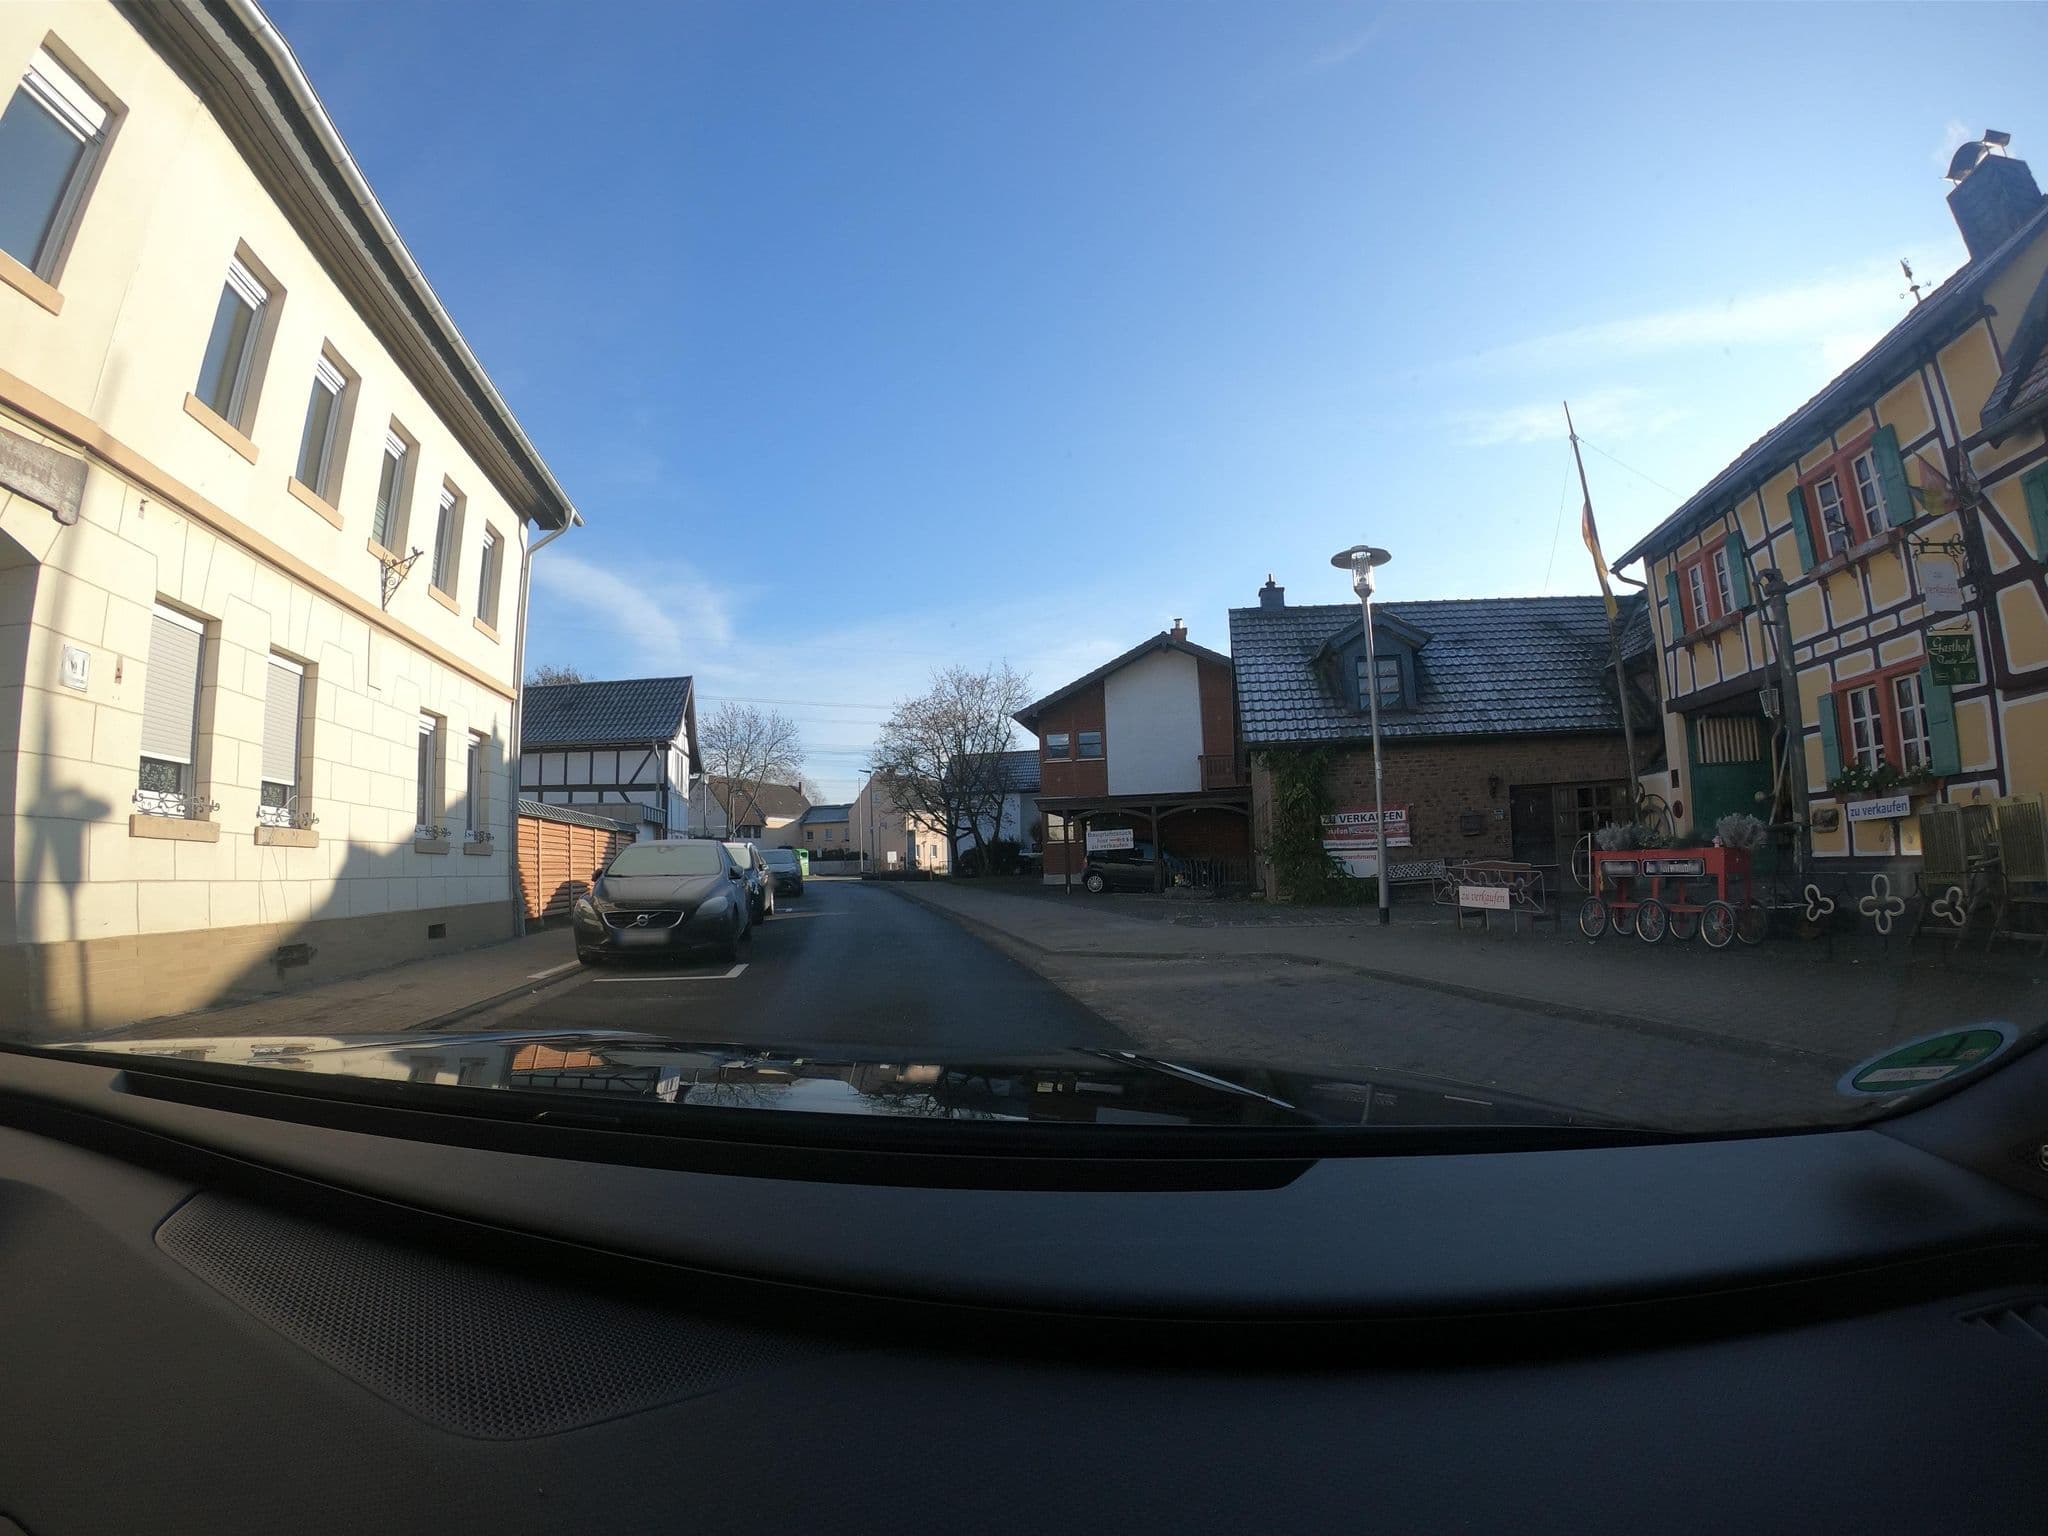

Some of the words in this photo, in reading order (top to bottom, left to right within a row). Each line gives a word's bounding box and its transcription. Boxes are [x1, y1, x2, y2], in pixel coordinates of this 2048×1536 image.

[1928, 636, 1970, 655] Gasthof
[1850, 808, 1860, 817] zu
[1862, 800, 1908, 816] verkaufen
[1339, 811, 1403, 824] VERKAFEN
[1461, 892, 1470, 901] zu
[1471, 890, 1505, 905] verkaufen
